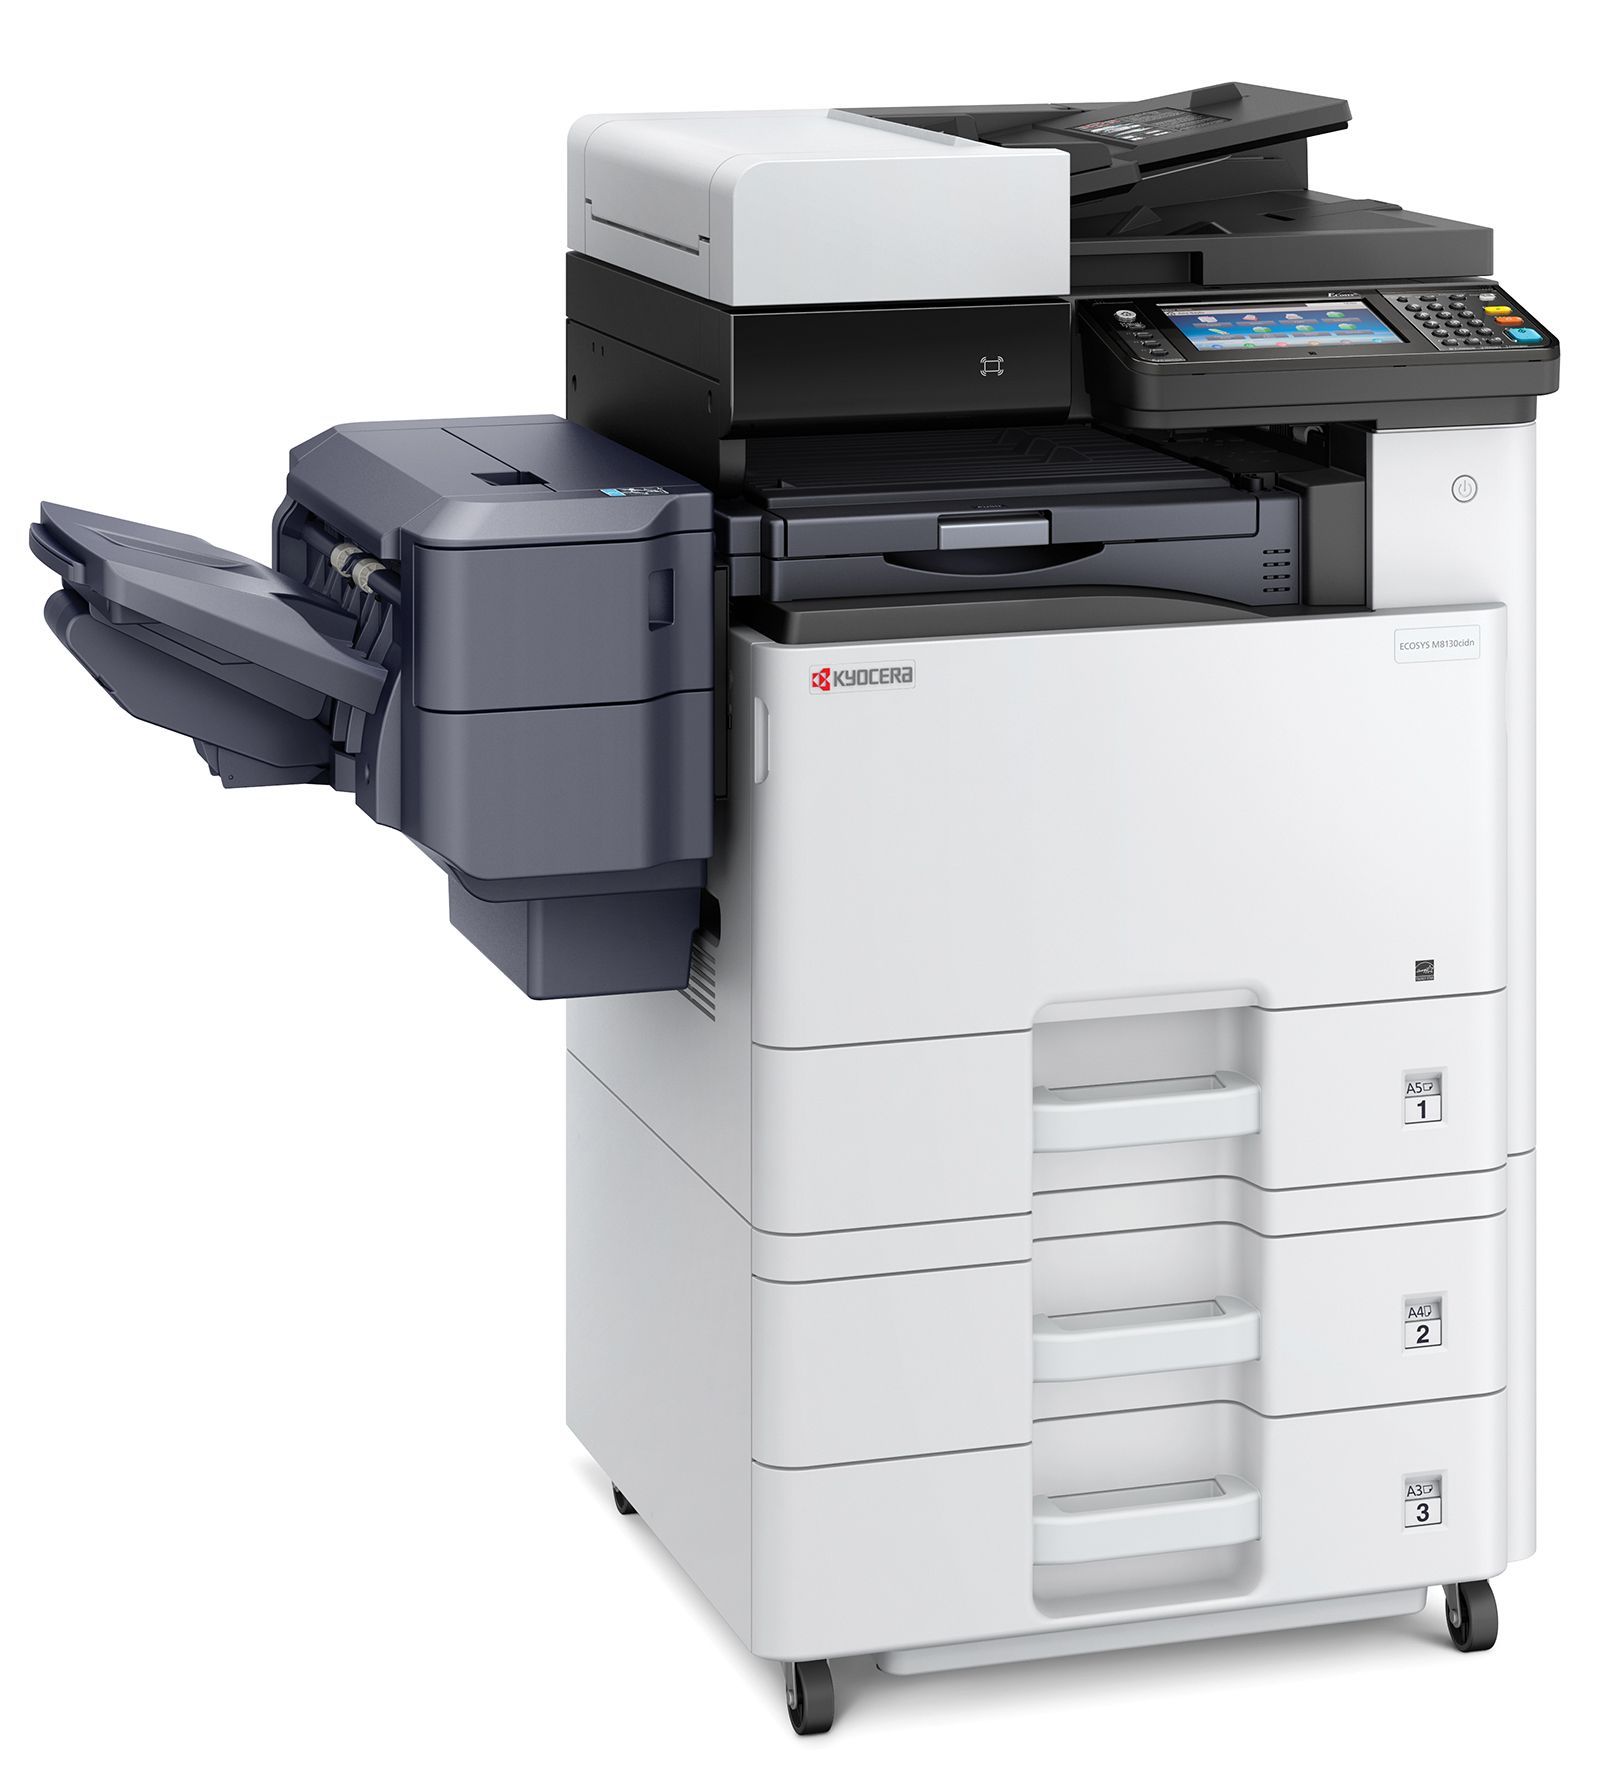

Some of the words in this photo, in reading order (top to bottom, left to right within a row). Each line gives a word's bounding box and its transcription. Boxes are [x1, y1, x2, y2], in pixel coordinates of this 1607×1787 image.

[1399, 641, 1430, 651] ECOSYS
[1431, 638, 1475, 649] M8130cidn
[833, 666, 913, 687] KYOCERA
[1406, 1082, 1423, 1094] A5
[1417, 1100, 1426, 1119] 1
[1408, 1306, 1424, 1319] A4
[1416, 1324, 1430, 1344] 2
[1406, 1484, 1423, 1498] A3
[1416, 1503, 1430, 1522] 3
